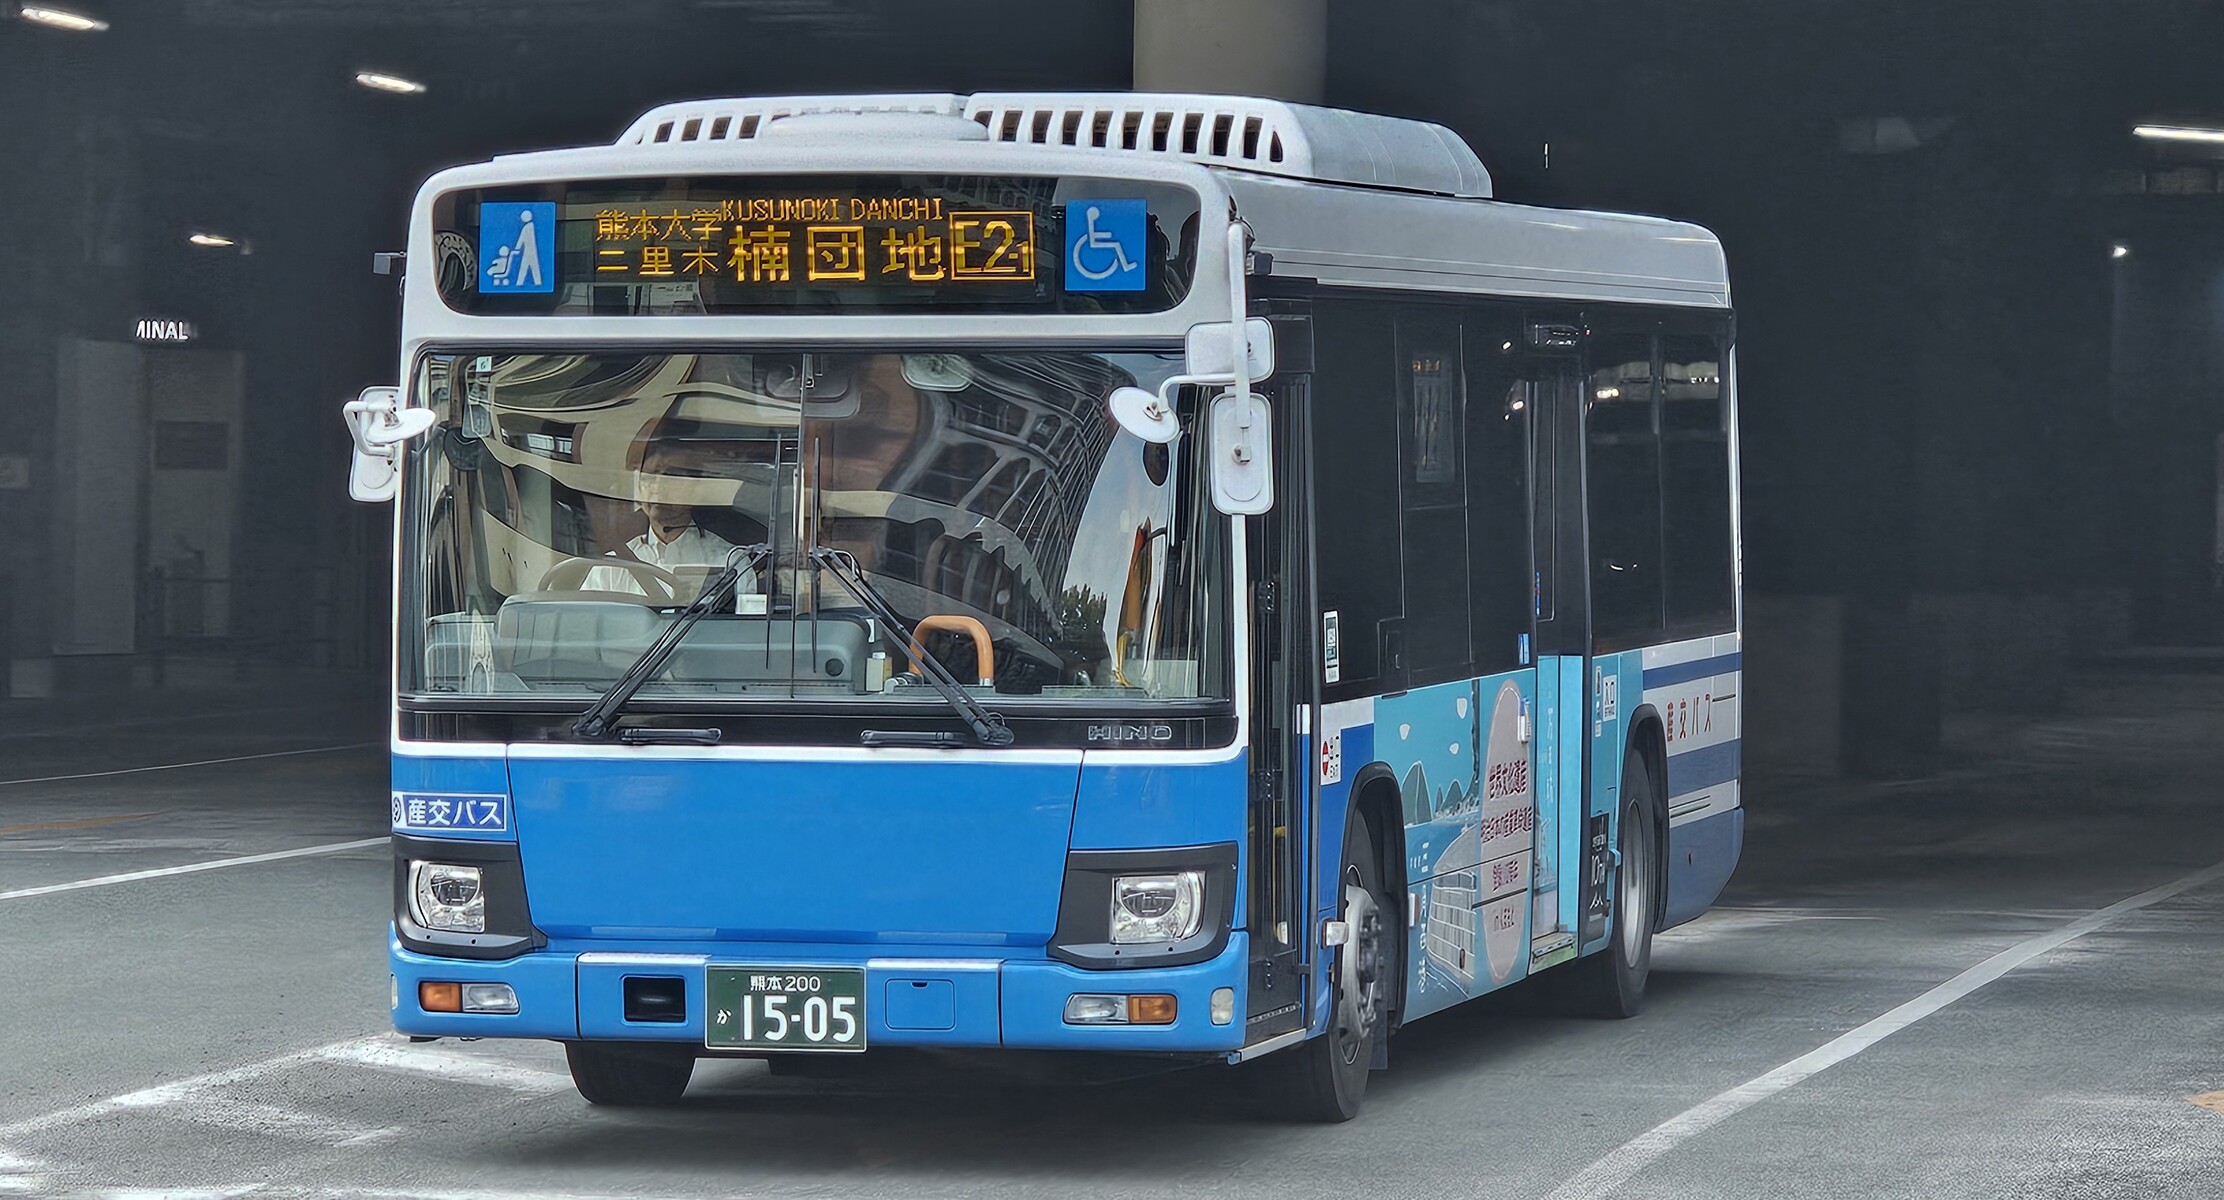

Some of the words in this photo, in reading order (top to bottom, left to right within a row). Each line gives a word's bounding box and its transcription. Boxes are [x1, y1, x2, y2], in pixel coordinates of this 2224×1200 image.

[595, 208, 723, 242] 熊本大学
[722, 198, 840, 221] KUSUNOKI
[850, 198, 943, 221] DANCHI
[727, 224, 946, 282] 楠団地
[1087, 725, 1172, 740] HINO
[408, 798, 502, 826] 産交バス
[716, 1009, 732, 1025] か
[743, 995, 856, 1042] 15-05
